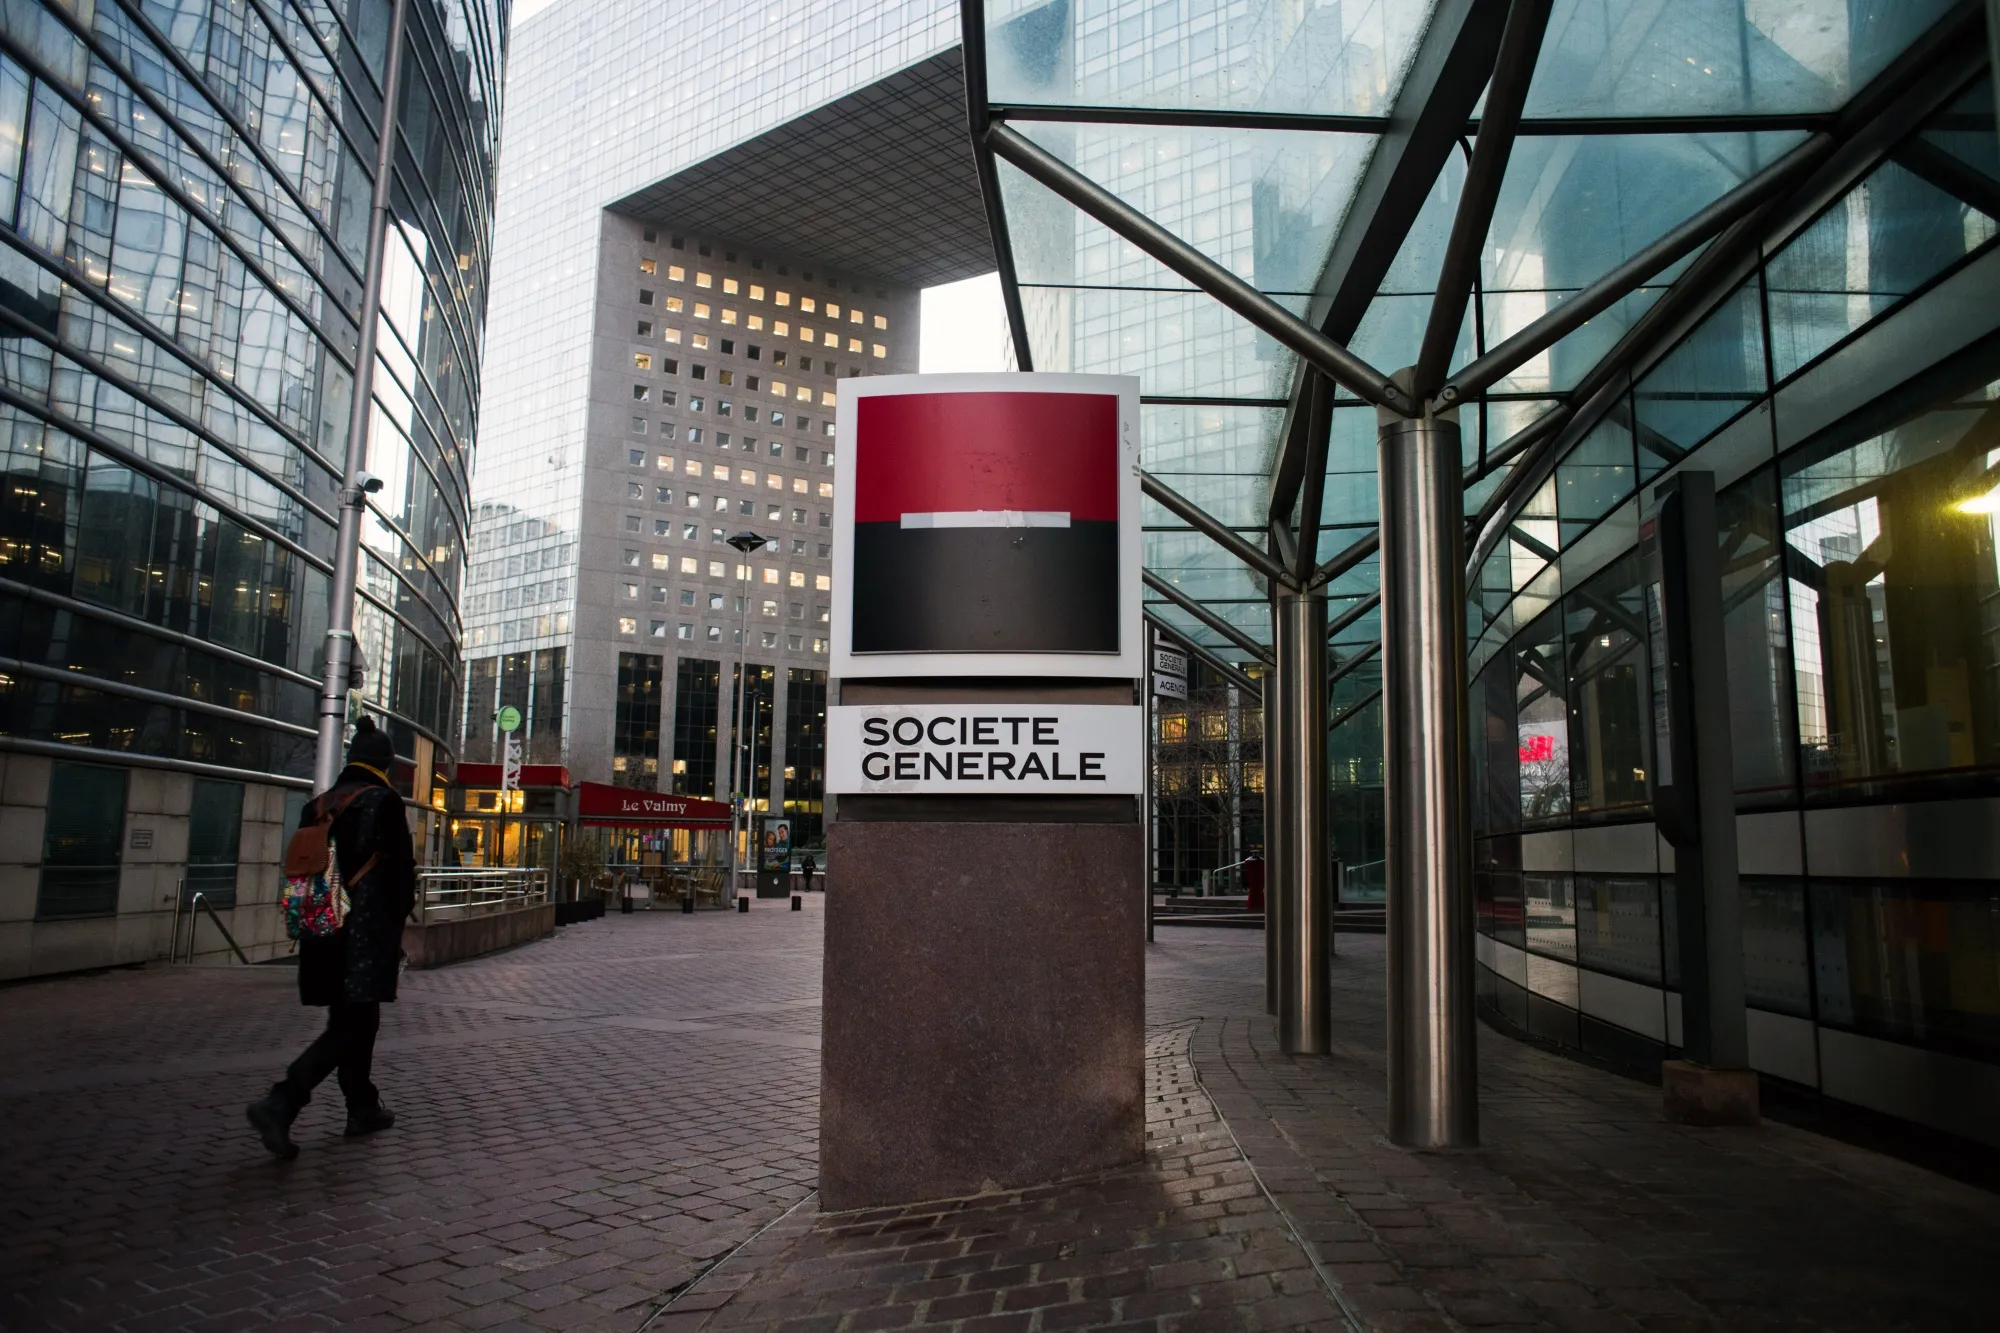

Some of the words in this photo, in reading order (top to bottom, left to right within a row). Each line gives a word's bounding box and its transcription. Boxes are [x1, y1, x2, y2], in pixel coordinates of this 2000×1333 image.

[1160, 681, 1185, 695] AGENCE
[863, 716, 1059, 746] SOCIETE
[861, 752, 1106, 781] GENERALE
[621, 800, 639, 811] Le
[643, 800, 687, 815] Valmy
